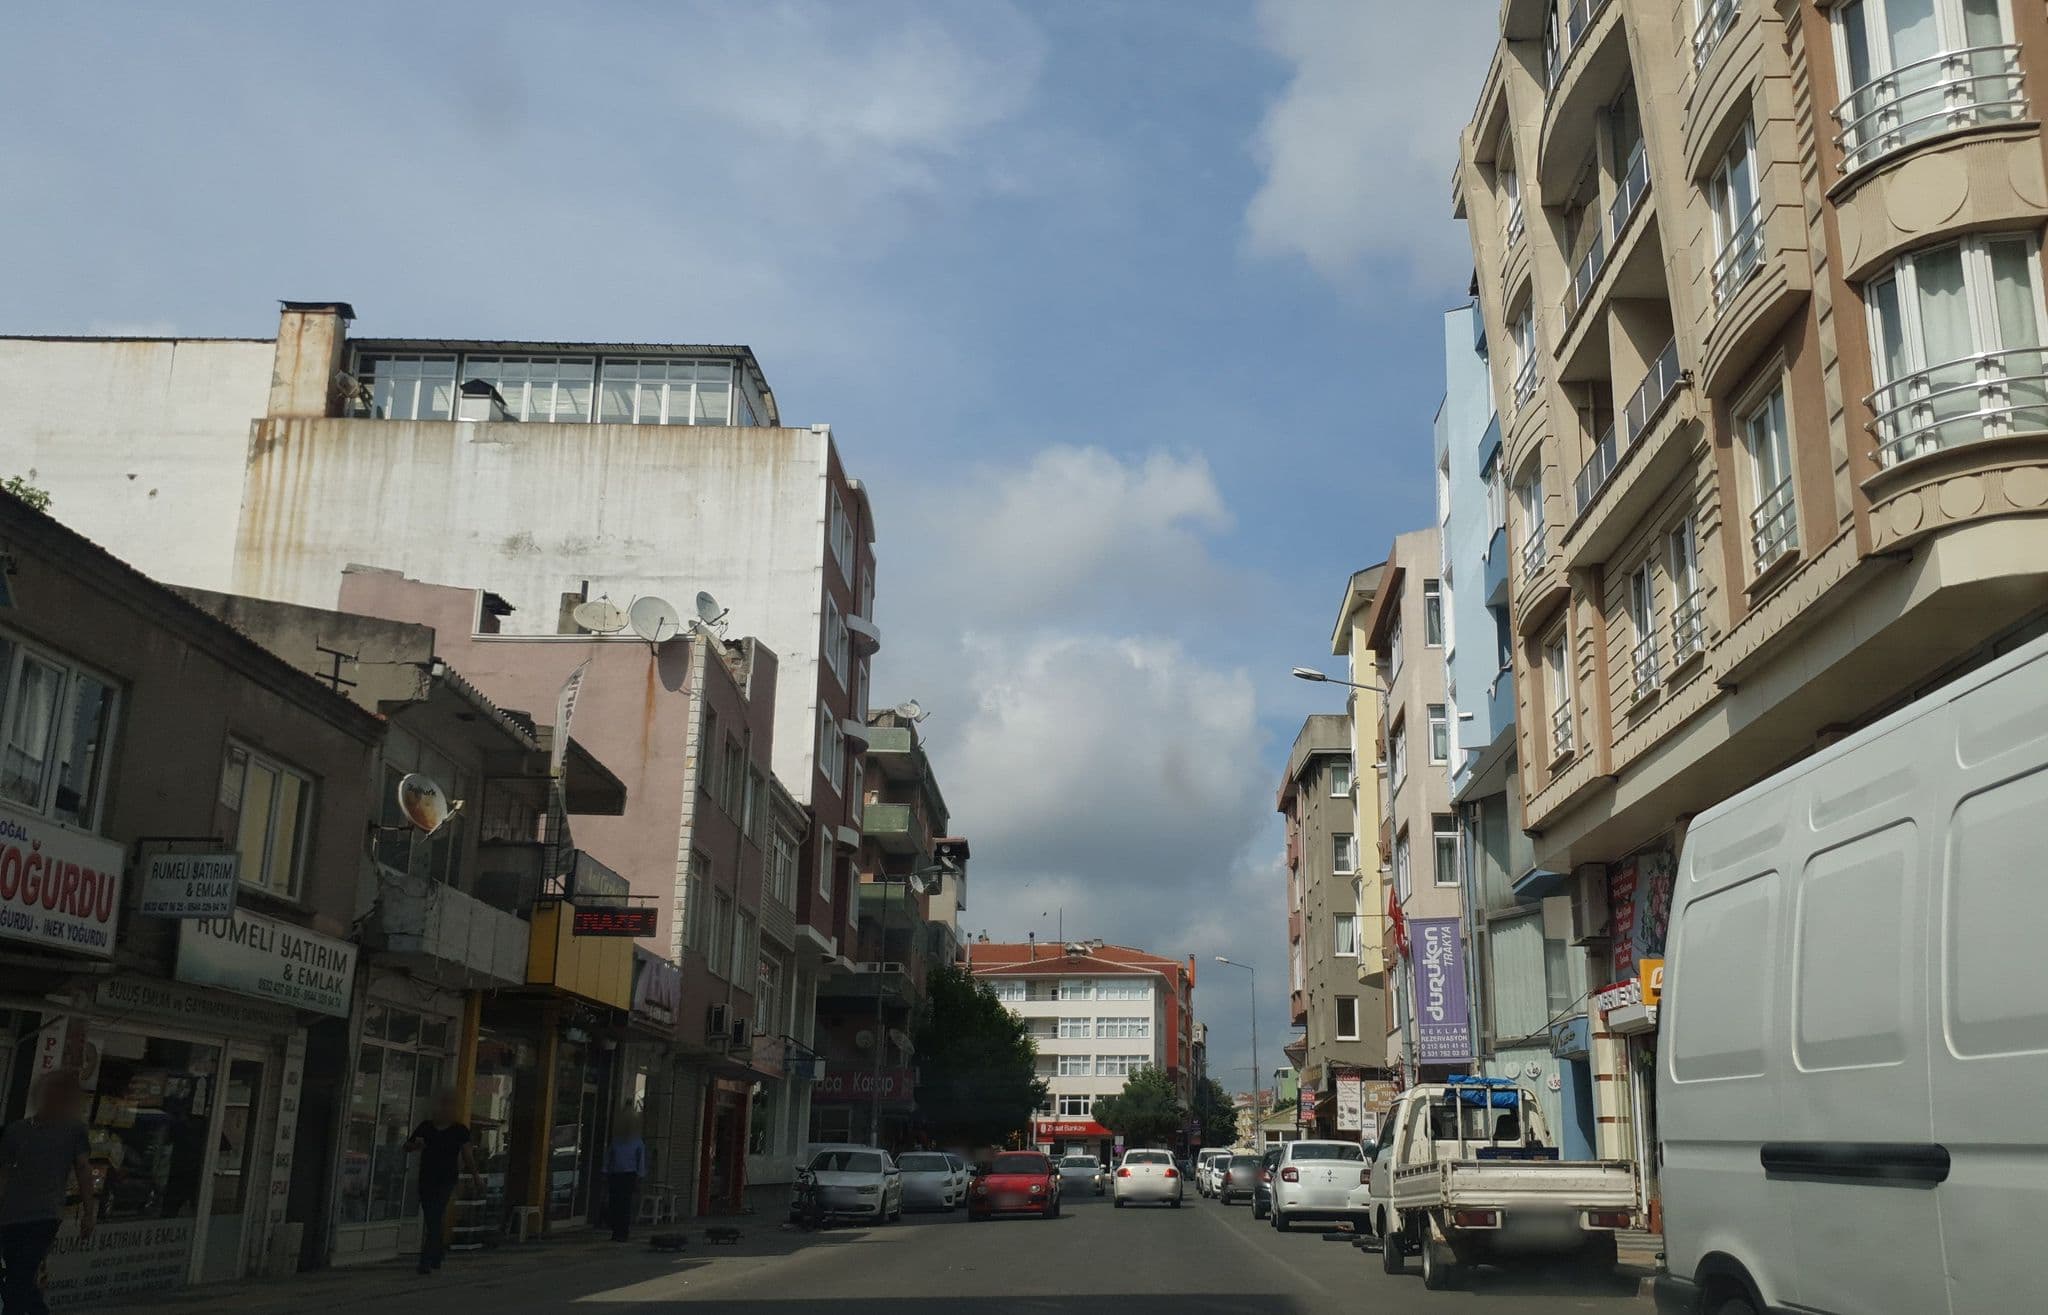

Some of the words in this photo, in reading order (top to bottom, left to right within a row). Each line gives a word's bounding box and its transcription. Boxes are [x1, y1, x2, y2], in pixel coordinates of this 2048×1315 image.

[192, 861, 233, 880] YATIRIM
[186, 882, 193, 897] &
[196, 882, 228, 897] EMLAK
[280, 933, 348, 974] YATIRIM
[1441, 926, 1454, 966] TRAKYA
[283, 964, 293, 981] &
[298, 967, 344, 993] EMLAK
